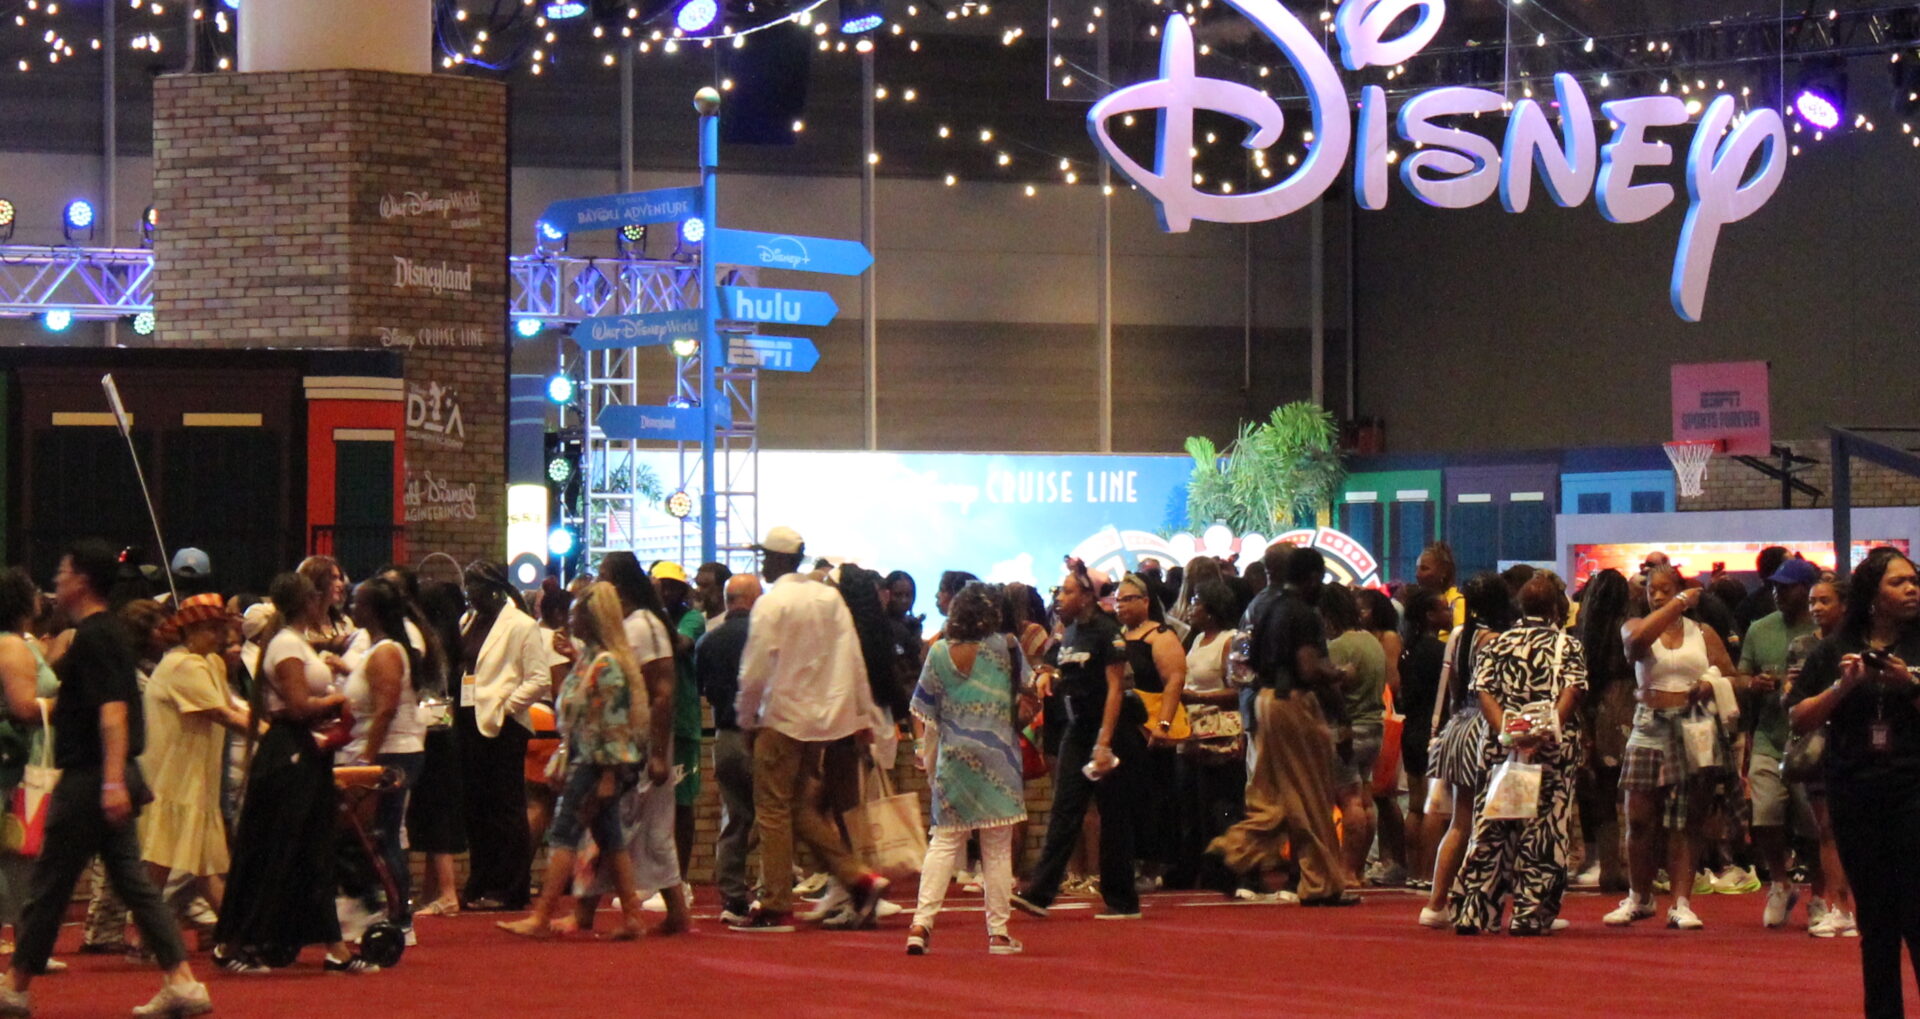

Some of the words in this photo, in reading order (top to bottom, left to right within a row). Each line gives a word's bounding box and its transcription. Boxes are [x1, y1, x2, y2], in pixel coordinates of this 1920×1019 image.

[449, 190, 479, 212] World
[577, 208, 619, 224] BAYOU
[624, 201, 688, 222] ADVENTURE
[393, 255, 471, 294] Disneyland
[736, 289, 801, 321] hulu
[418, 328, 456, 346] CRUISE
[461, 328, 484, 346] LINE
[665, 319, 698, 334] World
[728, 338, 793, 367] ESPN
[1682, 412, 1718, 430] SPORTS
[1720, 411, 1761, 428] FOREVER
[986, 470, 1073, 503] CRUISE
[1087, 470, 1138, 503] LINE
